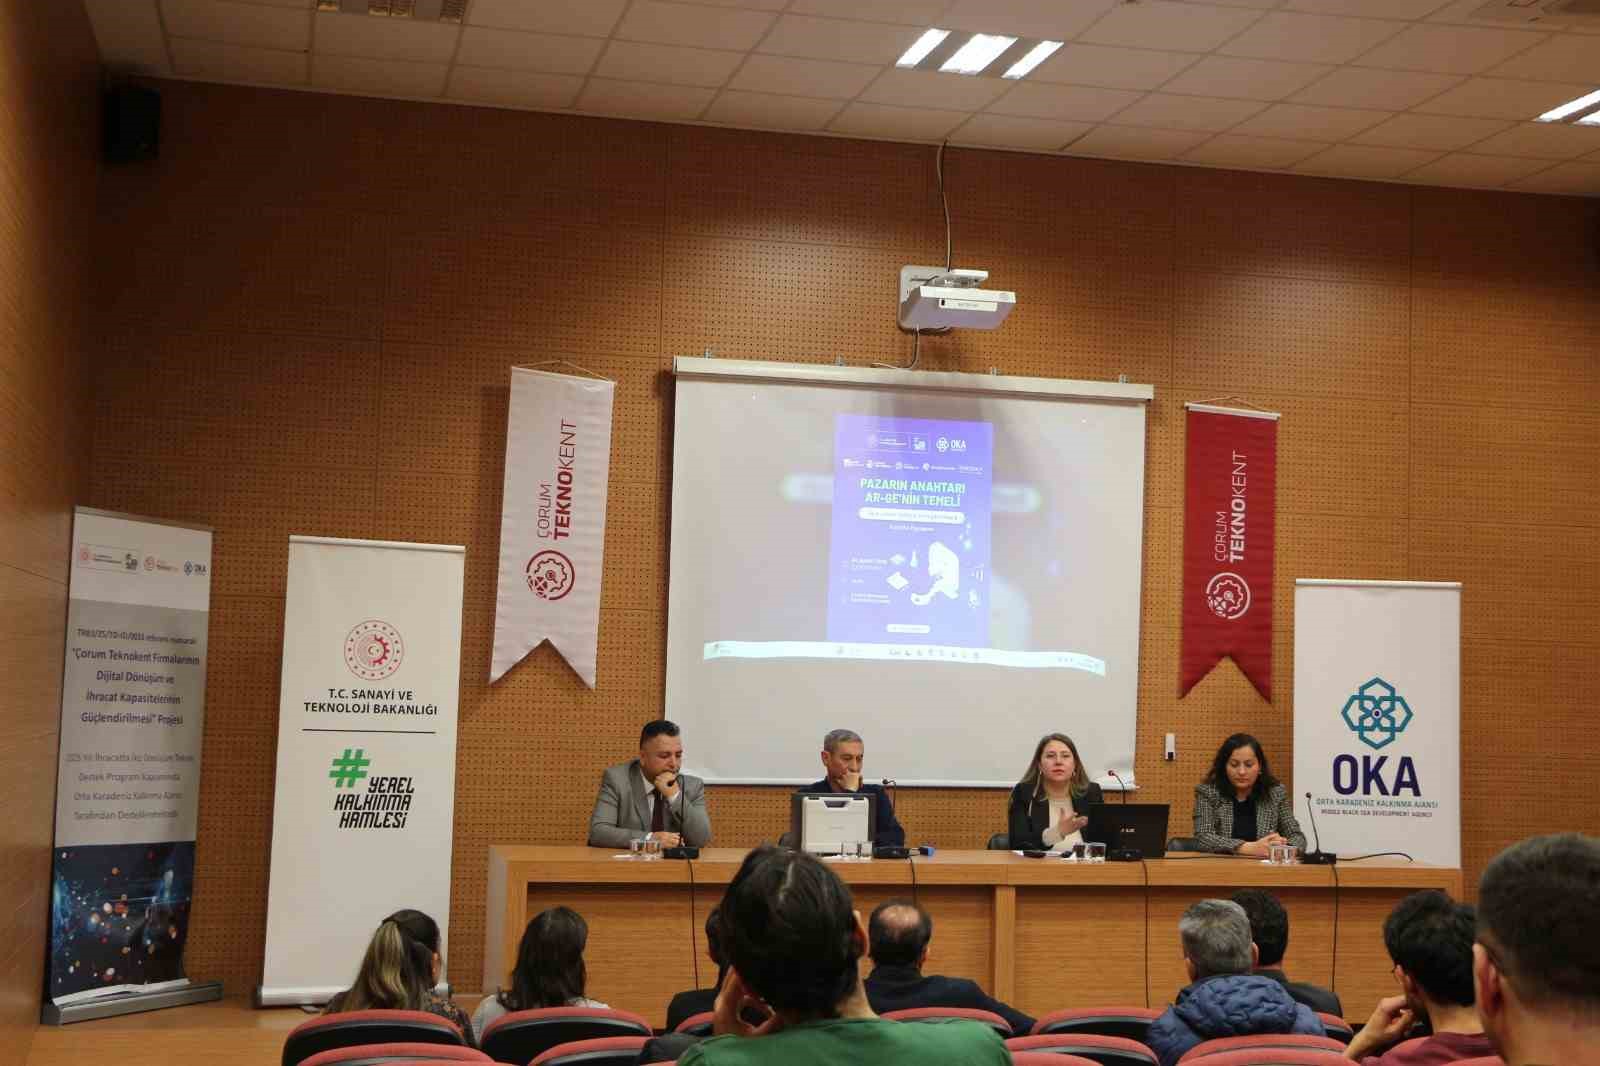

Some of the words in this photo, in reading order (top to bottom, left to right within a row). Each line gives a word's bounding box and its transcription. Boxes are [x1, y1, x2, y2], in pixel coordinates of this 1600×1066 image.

[554, 416, 576, 540] TEKNOKENT
[860, 479, 908, 491] PAZARIN
[910, 480, 965, 494] ANAHTARI
[537, 484, 552, 539] ÇORUM
[1230, 450, 1247, 563] TEKNOKENT
[1215, 511, 1228, 562] ÇORUM
[109, 650, 152, 662] Teknokent
[96, 670, 123, 684] Dijital
[328, 689, 349, 699] T.C.
[351, 689, 395, 700] SANAYİ
[398, 691, 413, 700] VE
[304, 702, 371, 713] TEKNOLOJİ
[373, 703, 438, 715] BAKANLIĞI
[1333, 754, 1421, 797] OKA
[368, 777, 415, 794] YEREL
[334, 794, 411, 811] KALKINMA
